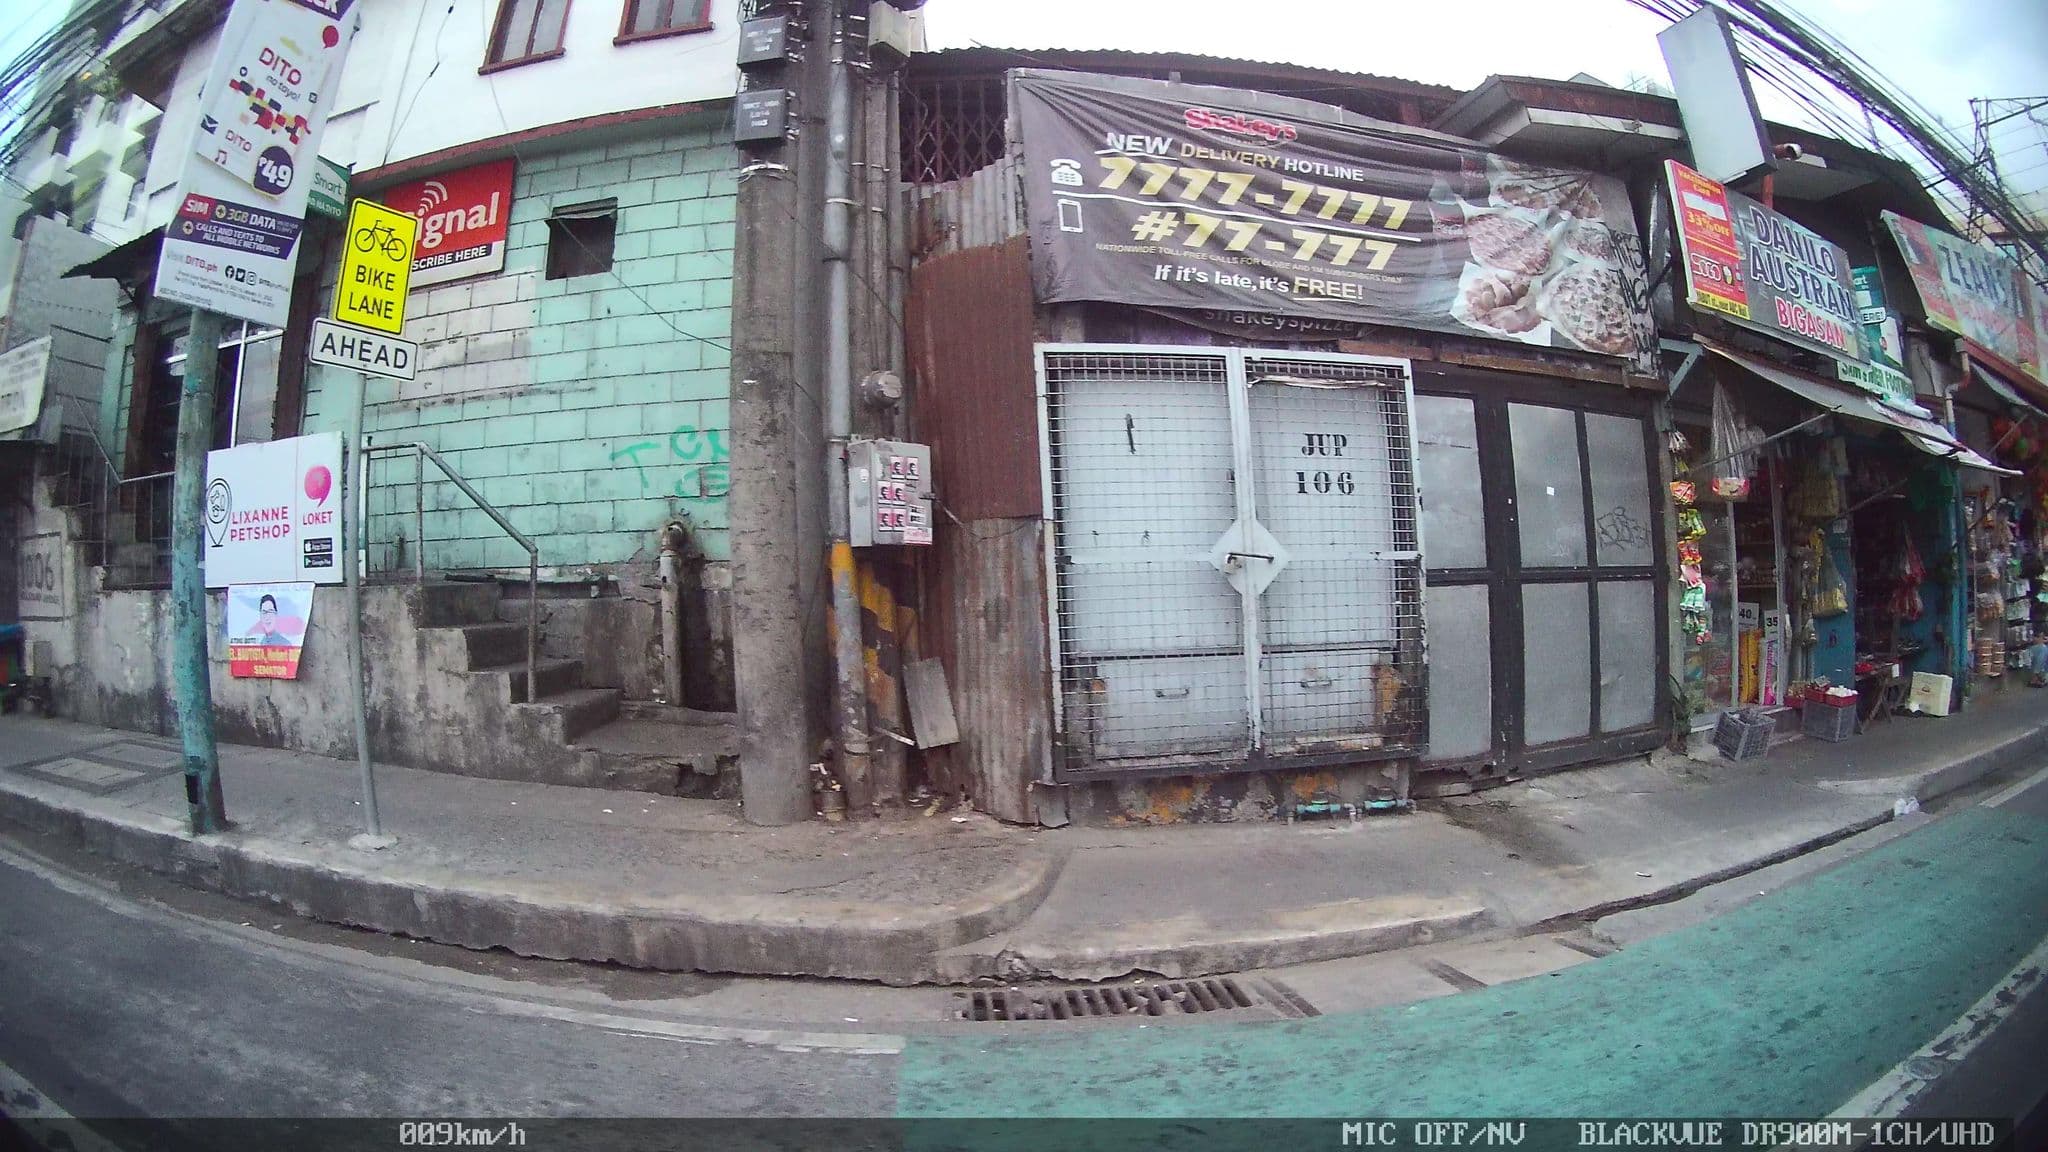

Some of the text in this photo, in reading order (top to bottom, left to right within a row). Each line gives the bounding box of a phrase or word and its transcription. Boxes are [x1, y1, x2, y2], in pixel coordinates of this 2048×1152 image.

[259, 47, 302, 85] DITO
[225, 129, 252, 152] DITO
[1106, 132, 1364, 182] NEW DELIVERY HOTLINE
[314, 172, 342, 195] Smart
[1099, 156, 1412, 230] 7777-7777
[186, 199, 209, 215] SIM
[226, 208, 249, 223] 3GB
[249, 214, 276, 230] DATA
[404, 190, 500, 249] ignal
[1095, 243, 1157, 254] NATIONWIDE
[1158, 246, 1208, 260] TOLL-FREE
[1209, 254, 1239, 264] CALLS
[1240, 256, 1260, 265] FOR
[1131, 211, 1398, 271] #77-777
[1749, 205, 1838, 280] DANILO
[412, 247, 487, 271] SCRIBE HERE
[355, 265, 396, 291] BIKE
[1155, 264, 1364, 300] If it's late, it's FREE!
[1750, 243, 1857, 323] AUSTRAN
[348, 292, 396, 320] LANE
[1861, 310, 1884, 322] ERE!
[1775, 296, 1848, 352] BIGASAN
[320, 333, 408, 370] AHEAD
[1302, 433, 1347, 456] JUP
[1296, 471, 1355, 495] 106
[232, 506, 289, 525] LIXANNE
[303, 511, 333, 526] LOKET
[230, 523, 291, 541] PETSHOP
[1739, 608, 1752, 619] 40
[1766, 616, 1778, 627] 35
